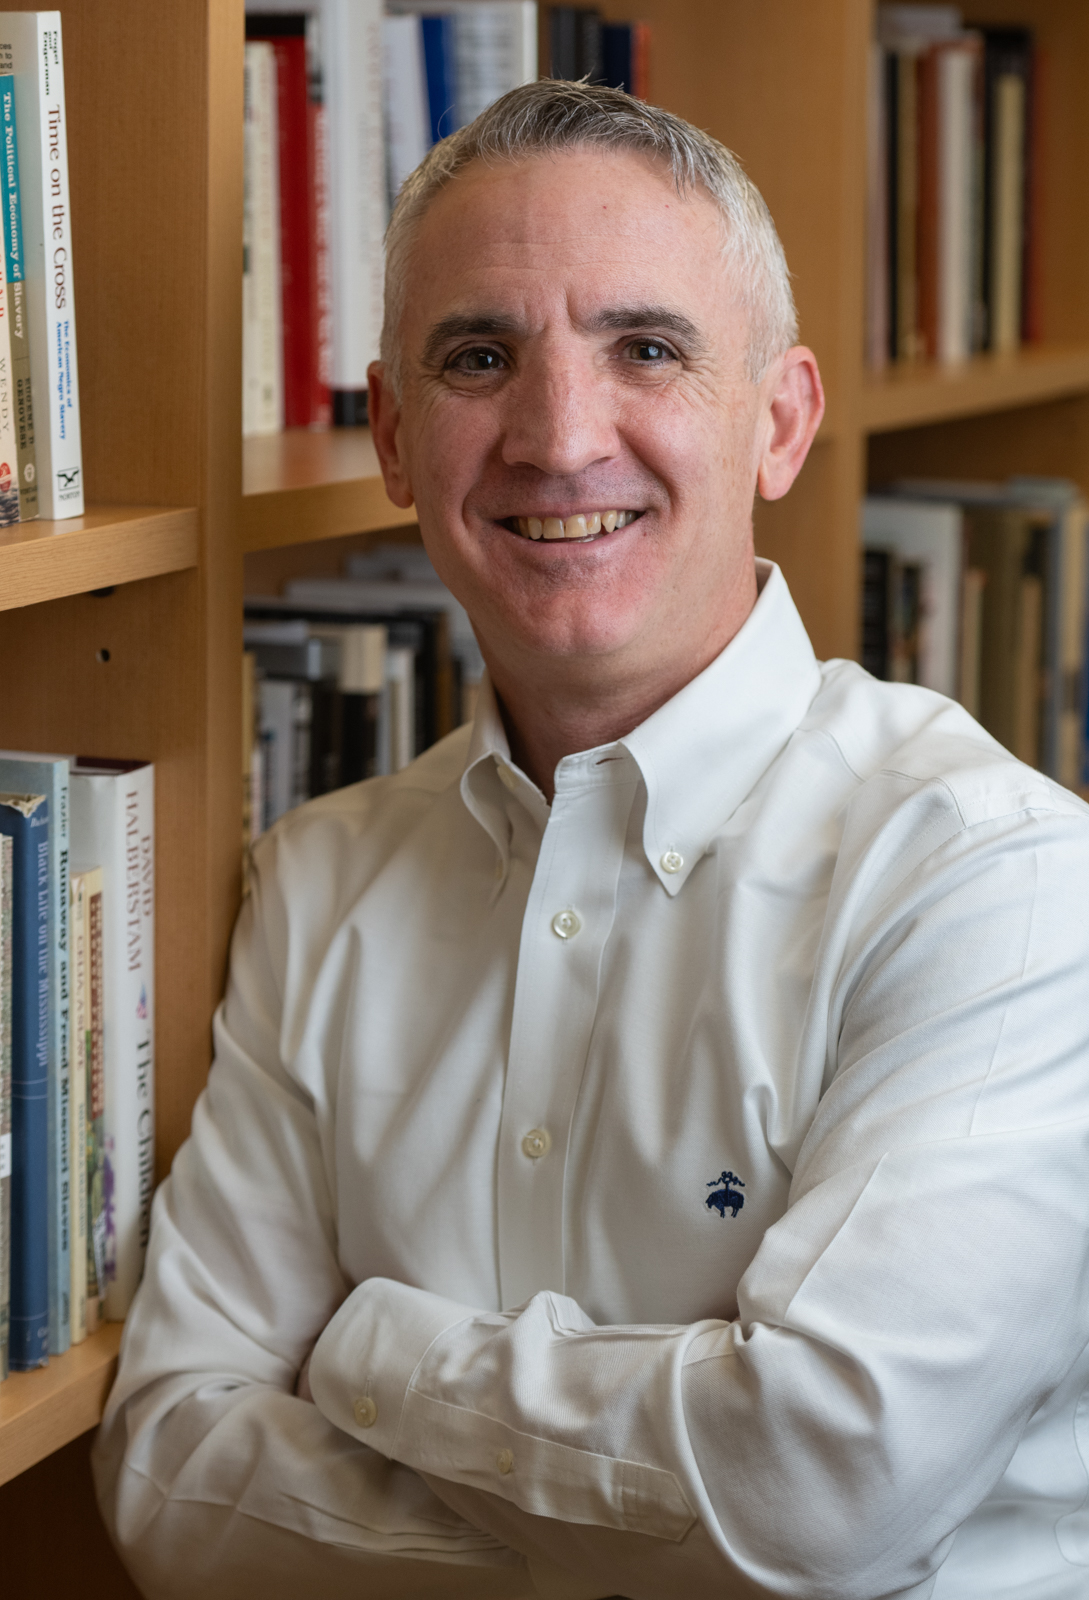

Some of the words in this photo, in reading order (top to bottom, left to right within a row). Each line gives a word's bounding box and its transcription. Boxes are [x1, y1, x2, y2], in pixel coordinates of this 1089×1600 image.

[3, 92, 11, 122] The
[48, 104, 61, 162] Time
[5, 126, 16, 188] Political
[50, 168, 62, 197] on
[9, 192, 19, 260] Economy
[52, 204, 66, 240] the
[13, 263, 22, 279] of
[53, 247, 68, 310] Cross
[14, 281, 24, 339] Slavery
[0, 357, 9, 432] WENDY
[57, 371, 65, 401] Negro
[64, 340, 72, 395] Economics
[17, 378, 27, 450] GENOVESE
[25, 377, 34, 431] EUGENE
[66, 398, 73, 408] of
[38, 842, 48, 886] Black
[126, 791, 142, 972] HALBERSTAM
[141, 835, 152, 917] DAVID
[58, 849, 68, 952] Runaway
[38, 925, 48, 946] on
[60, 961, 69, 1001] and
[36, 978, 49, 1068] Mississippi
[60, 1007, 69, 1070] Freed
[137, 1031, 152, 1099] The
[60, 1076, 69, 1174] Missouri
[61, 1181, 70, 1252] Slaves
